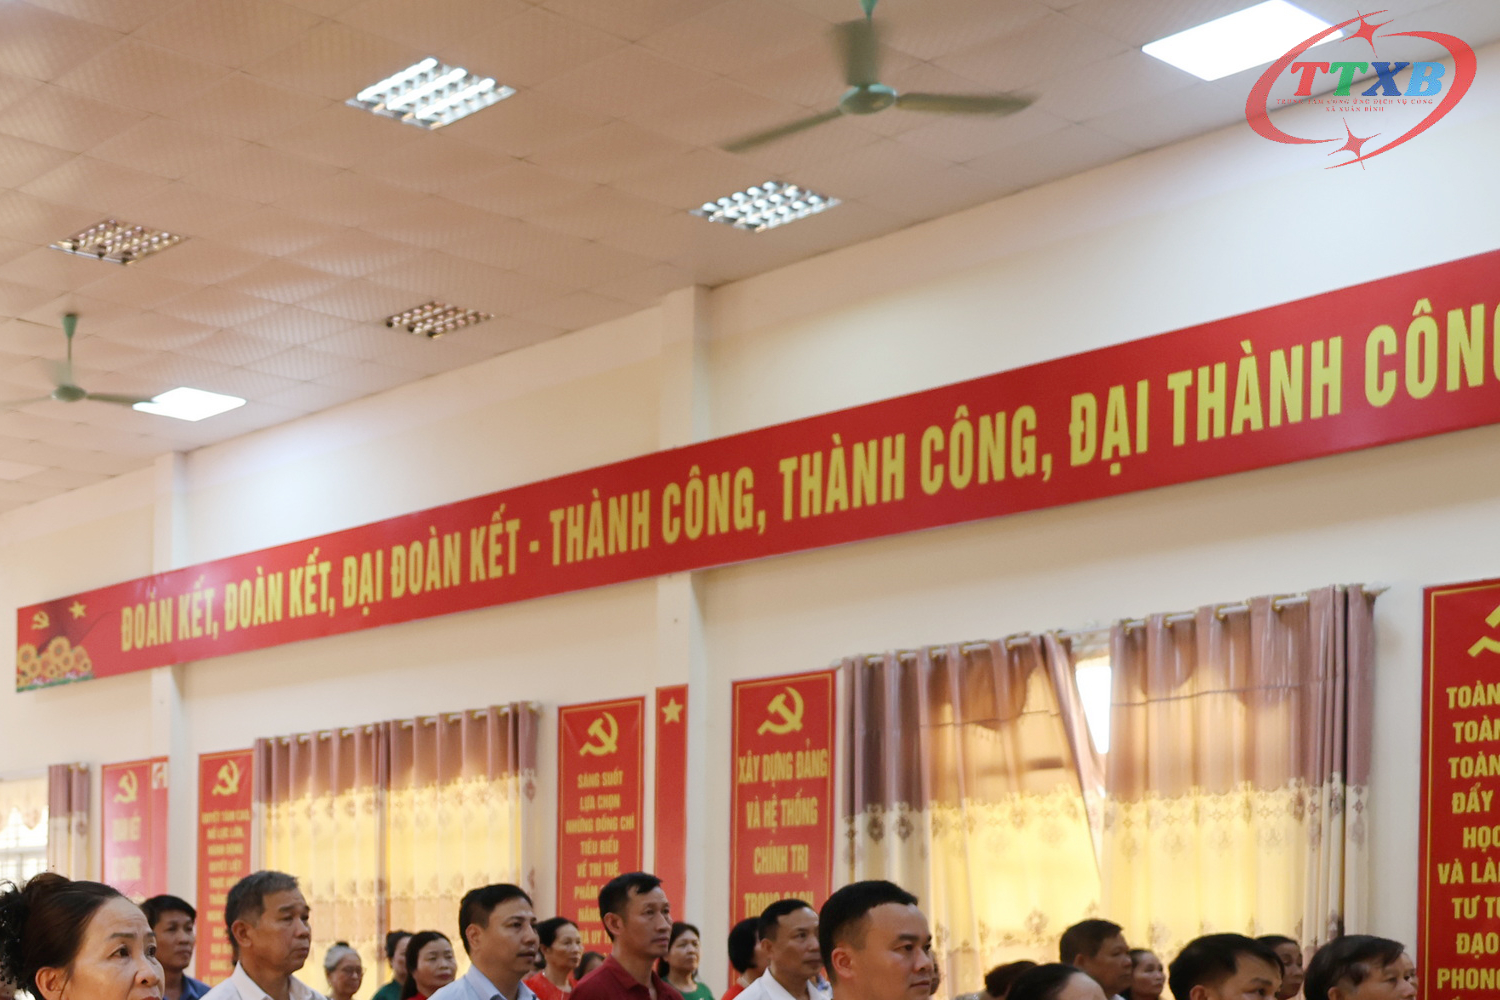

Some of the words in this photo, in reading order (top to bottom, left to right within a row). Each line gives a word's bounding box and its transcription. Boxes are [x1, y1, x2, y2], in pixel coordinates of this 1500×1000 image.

[121, 590, 173, 652] ĐOÀN
[177, 575, 219, 640] KẾT,
[224, 566, 283, 632] ĐOÀN
[289, 547, 335, 617] KẾT,
[342, 549, 384, 616] ĐẠI
[390, 525, 462, 598] ĐOÀN
[469, 503, 521, 583] KẾT
[549, 487, 651, 566] THÀNH
[661, 464, 767, 545] CÔNG,
[779, 432, 906, 522] THÀNH
[920, 404, 1053, 496] CÔNG,
[1068, 379, 1149, 476] ĐẠI
[1167, 338, 1343, 447] THÀNH
[1364, 297, 1500, 408] CÔN
[738, 750, 761, 784] XÂY
[761, 751, 794, 788] DỰNG
[795, 738, 829, 780] ĐẢNG
[746, 795, 761, 829] VÀ
[763, 793, 779, 834] HỆ
[780, 787, 819, 827] THỐNG
[1451, 782, 1494, 815] ĐẨY
[753, 839, 789, 875] CHÍNH
[790, 844, 810, 880] TRỊ
[1437, 858, 1465, 885] VÀ
[1471, 856, 1500, 885] LÀ
[1451, 894, 1481, 920] TƯ
[1455, 932, 1499, 959] ĐẠO
